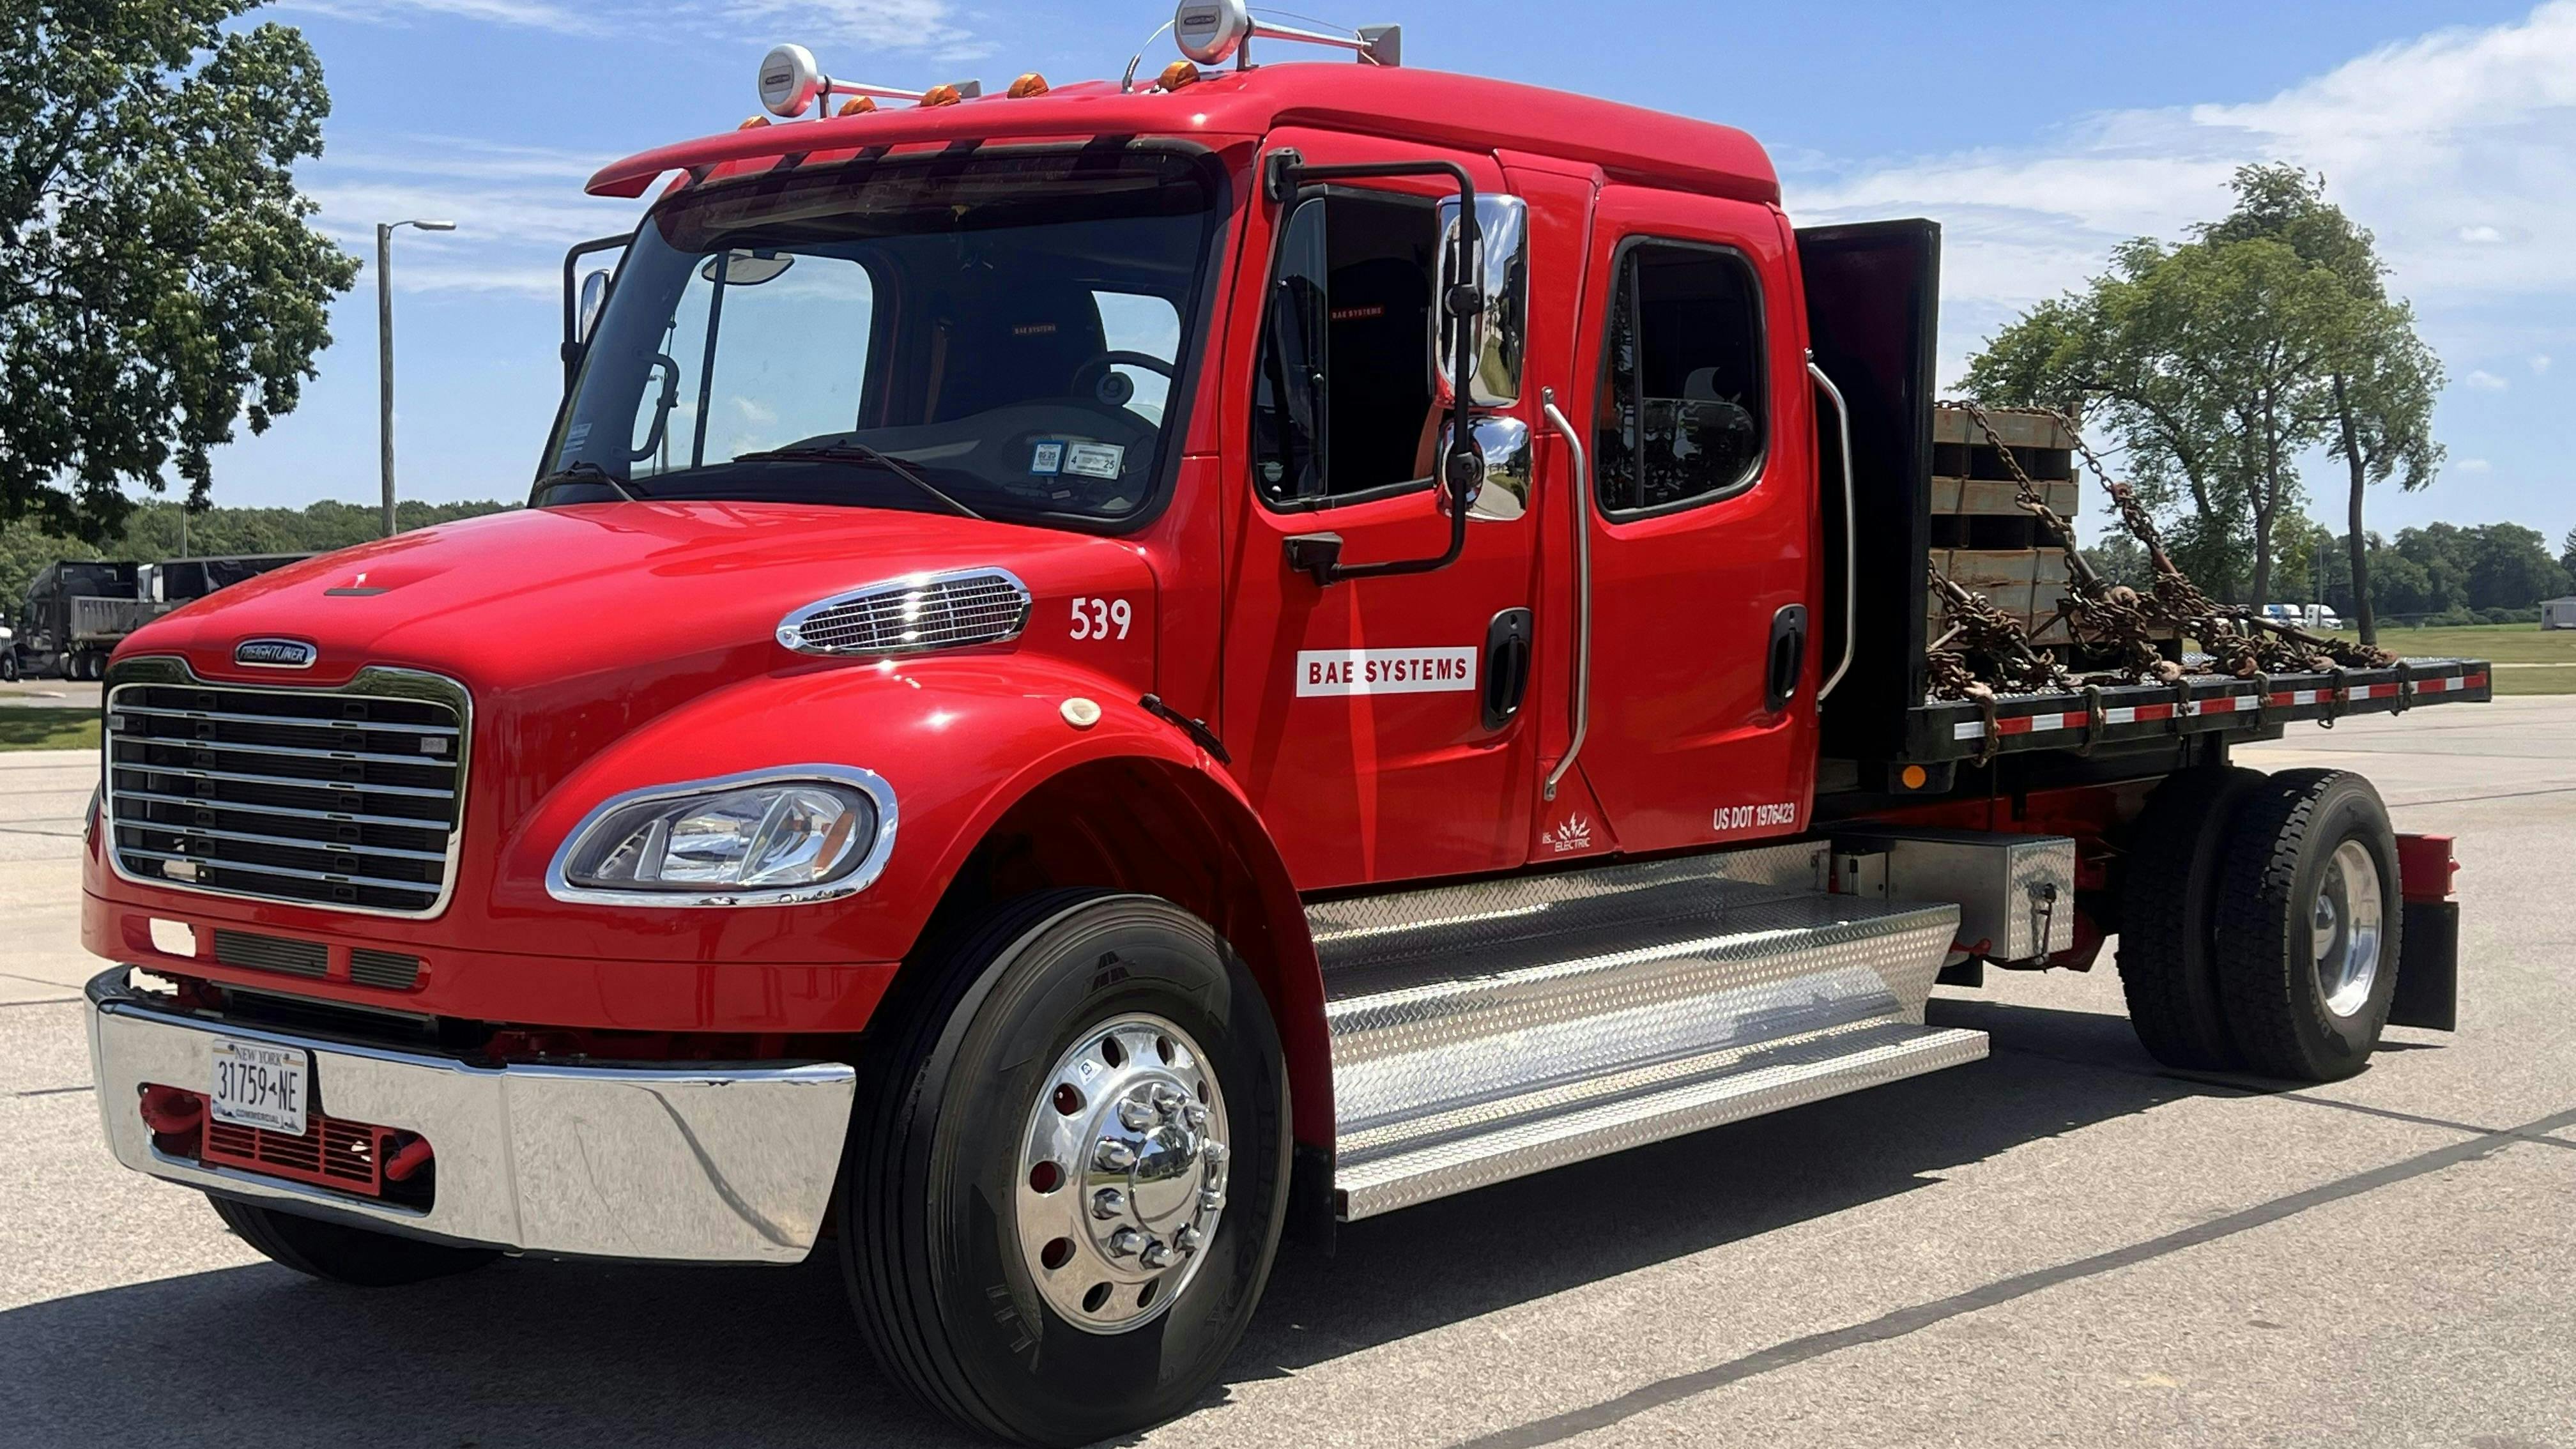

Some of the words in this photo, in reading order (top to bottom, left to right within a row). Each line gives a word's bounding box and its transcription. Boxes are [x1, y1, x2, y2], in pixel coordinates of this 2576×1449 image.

[1071, 456, 1077, 464] 4
[1103, 459, 1115, 470] 25
[1070, 597, 1131, 640] 539
[240, 645, 305, 661] FREIGHTLINER
[1309, 661, 1354, 684] BAE
[1365, 658, 1466, 682] SYSTEMS
[1713, 808, 1729, 830] US
[1731, 806, 1754, 829] DOT
[1757, 802, 1795, 826] 1976423
[1554, 837, 1591, 852] ELECTRIC
[235, 1046, 256, 1061] NEW
[259, 1050, 282, 1066] YORK
[236, 1109, 279, 1124] COMMERCIAL
